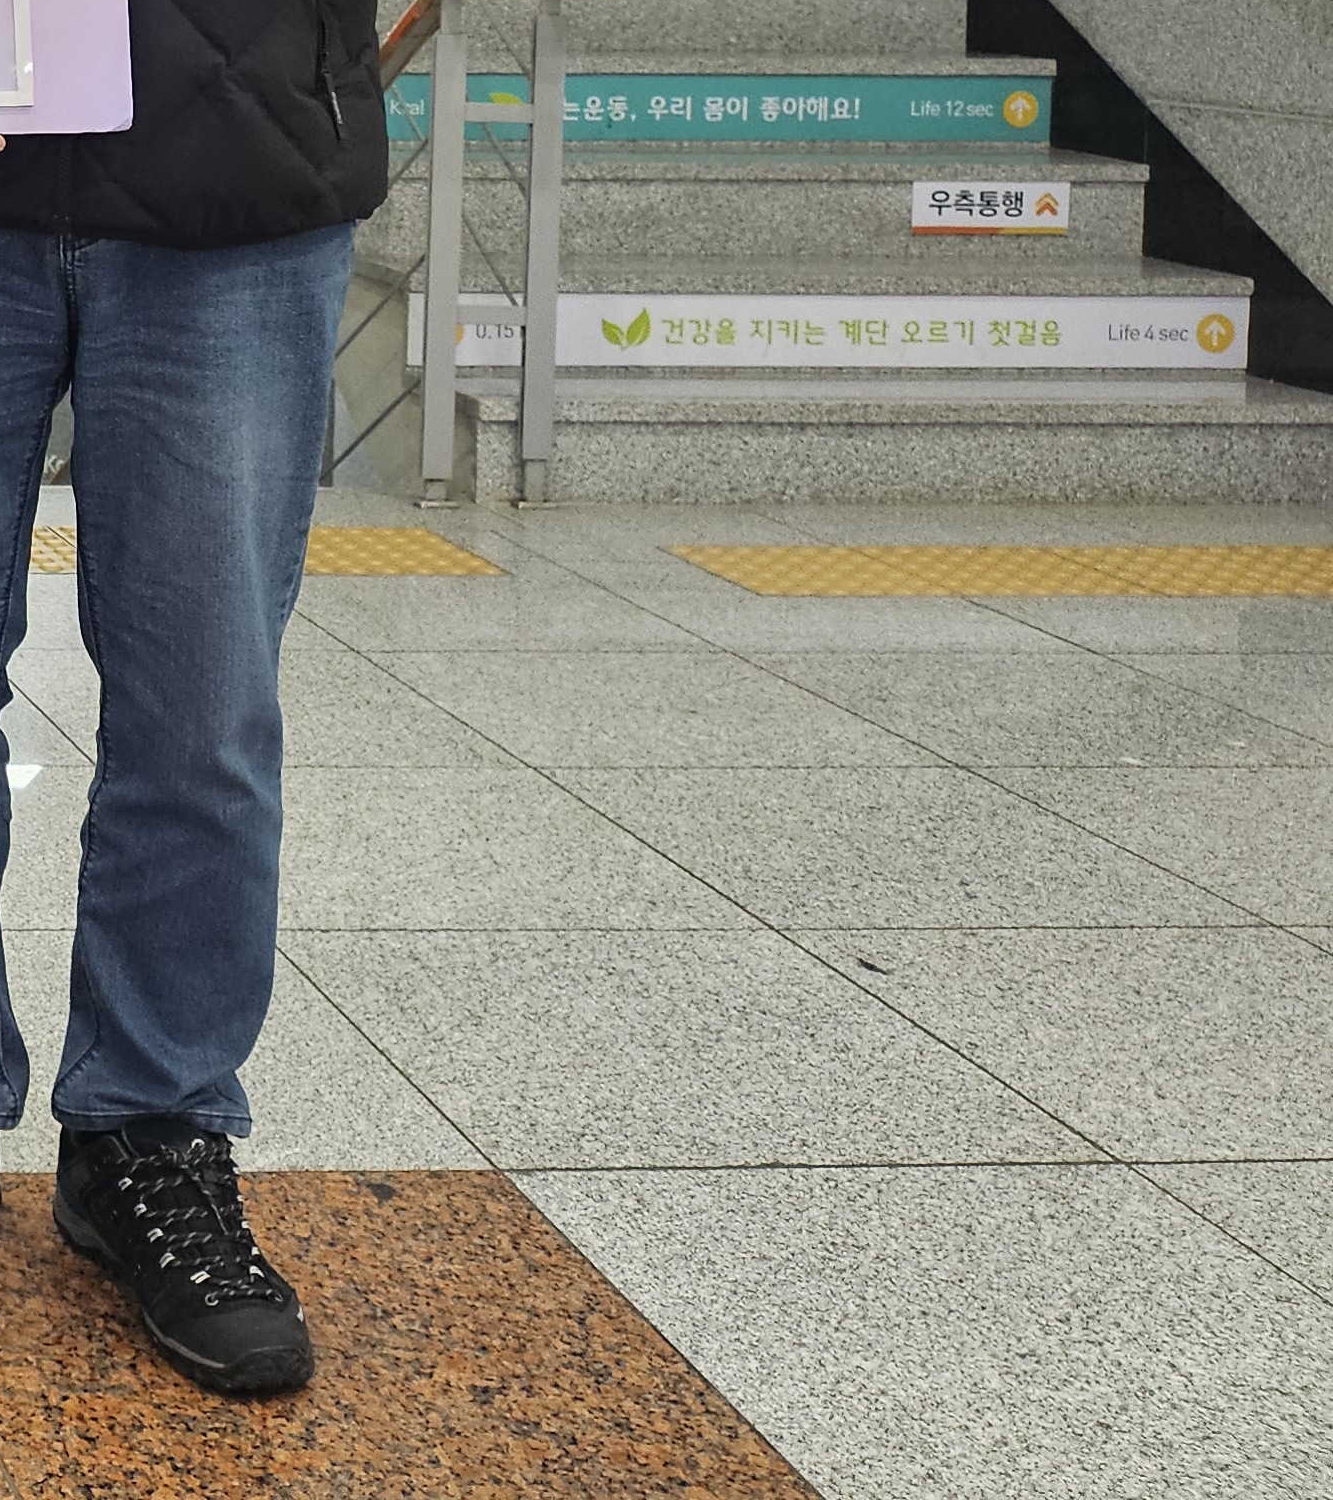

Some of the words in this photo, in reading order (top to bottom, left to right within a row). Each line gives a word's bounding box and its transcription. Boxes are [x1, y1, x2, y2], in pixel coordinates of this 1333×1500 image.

[647, 95, 693, 122] 우리
[703, 95, 749, 122] 몸이
[759, 95, 861, 122] 좋아해요!
[910, 100, 941, 117] Life
[928, 189, 1024, 218] 우측통행
[661, 317, 737, 346] 건강을
[749, 318, 827, 346] 지키는
[838, 318, 890, 347] 계단
[900, 319, 975, 346] 오르기
[988, 319, 1063, 347] 첫걸음
[1108, 323, 1141, 342] Life
